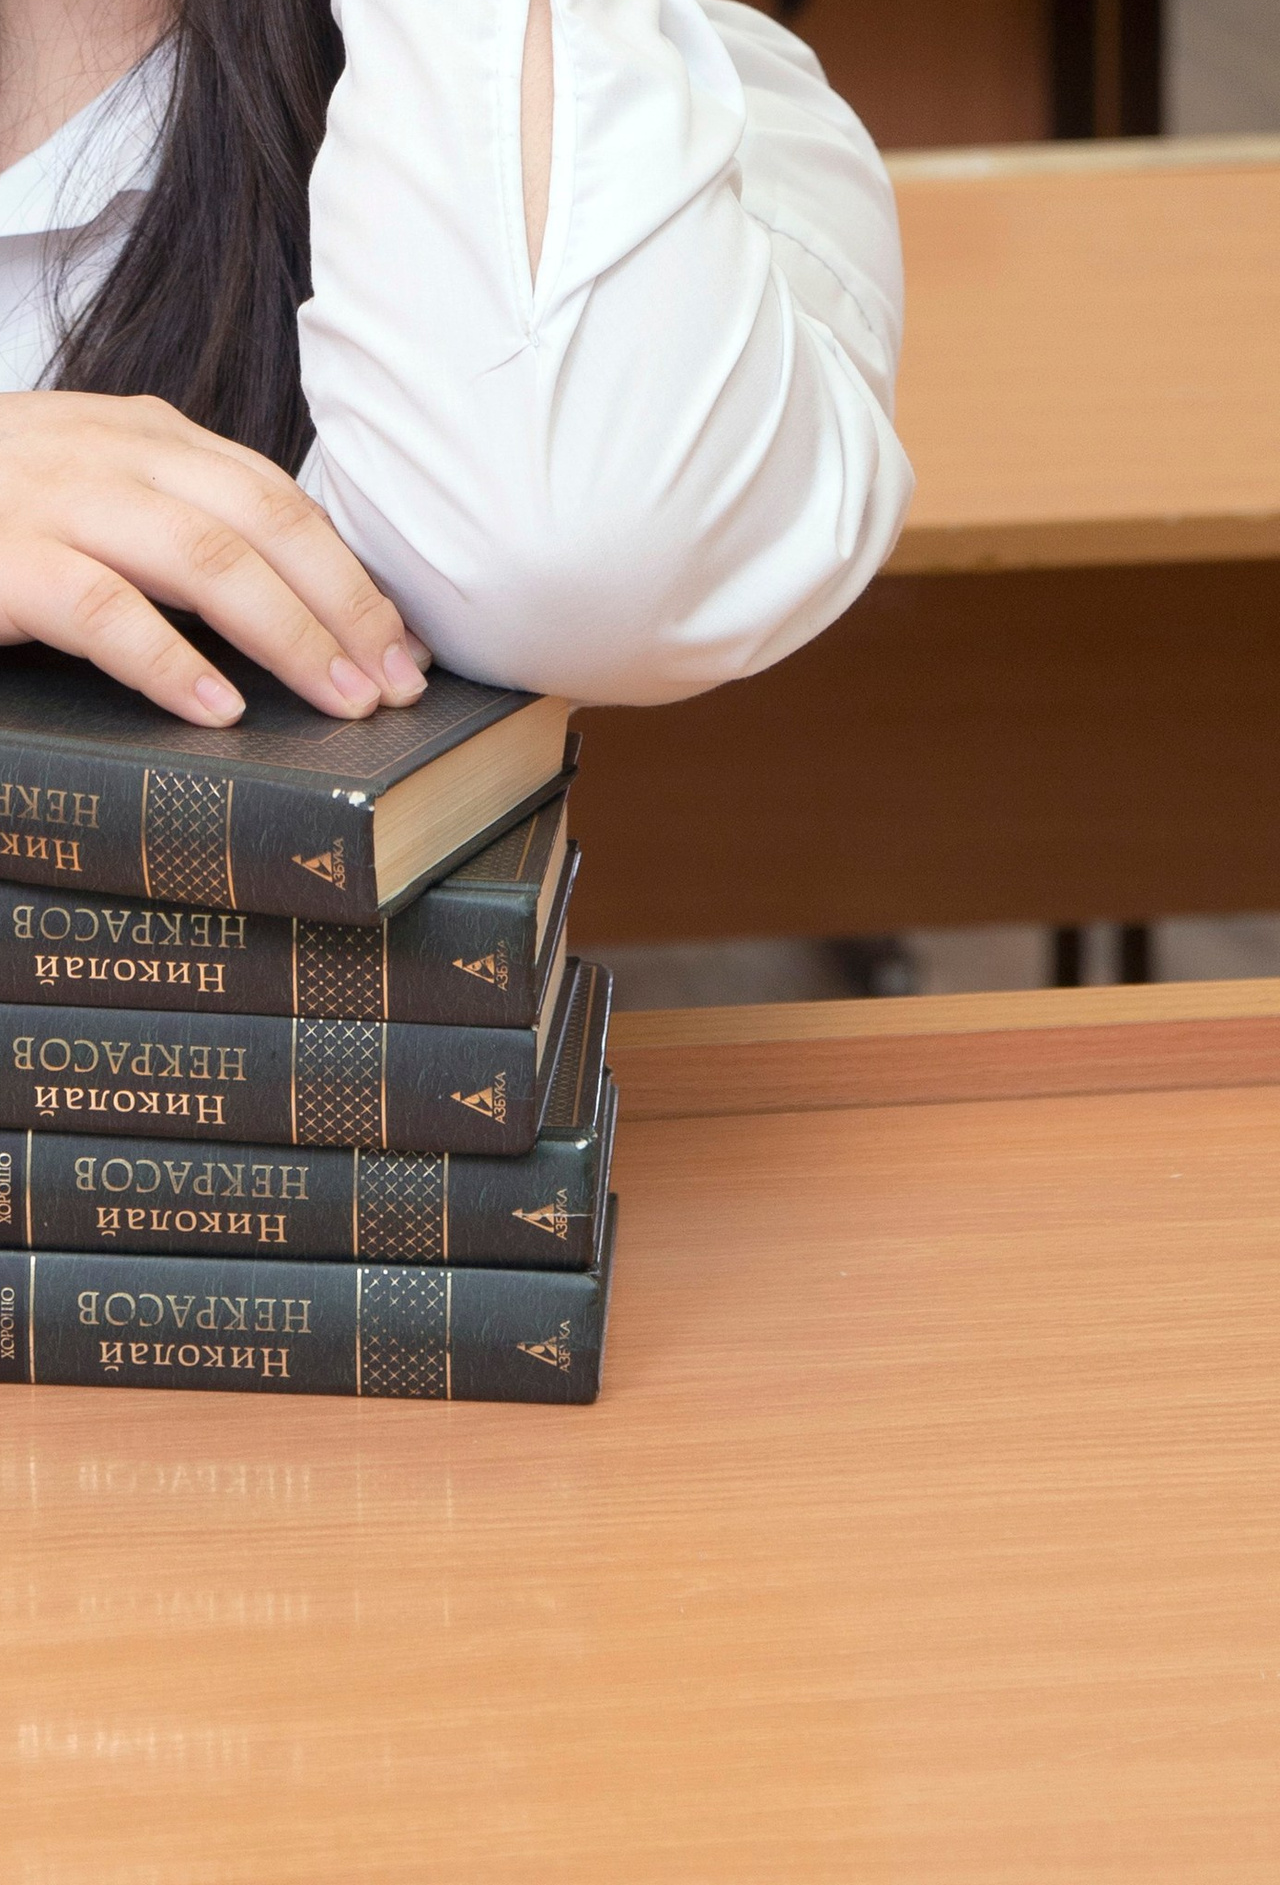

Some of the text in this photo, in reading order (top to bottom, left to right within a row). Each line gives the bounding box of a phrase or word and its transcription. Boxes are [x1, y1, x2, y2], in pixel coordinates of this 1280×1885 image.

[332, 837, 346, 891] АЗБУКА
[12, 905, 247, 949] НЕКРАСОВ
[34, 955, 226, 993] Николай
[496, 940, 509, 991] АЗБУКА
[12, 1036, 247, 1081] НЕКРАСОВ
[34, 1086, 227, 1125] Николай
[494, 1071, 507, 1125] АЗБУКА
[74, 1157, 309, 1200] НЕКРАСОВ
[96, 1207, 288, 1243] Николай
[555, 1188, 568, 1241] АЗБУКА
[0, 1287, 15, 1361] ХОРОШО
[77, 1291, 312, 1333] НЕКРАСОВ
[99, 1341, 291, 1378] Николай
